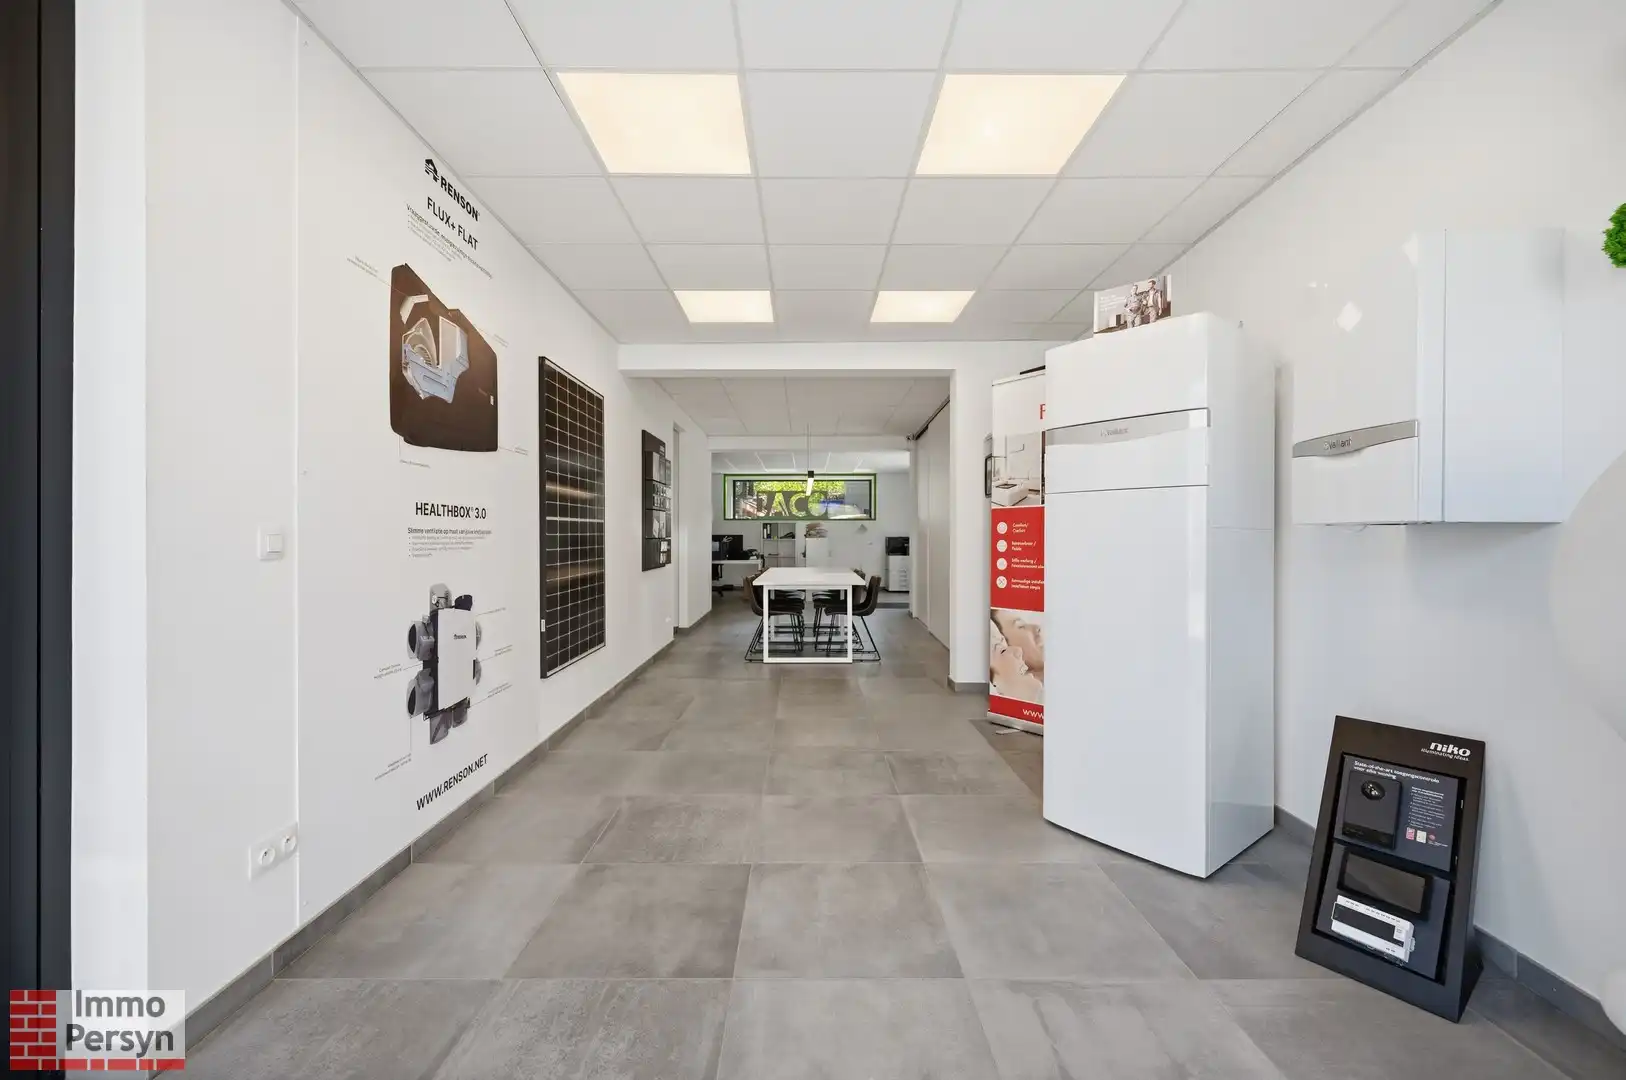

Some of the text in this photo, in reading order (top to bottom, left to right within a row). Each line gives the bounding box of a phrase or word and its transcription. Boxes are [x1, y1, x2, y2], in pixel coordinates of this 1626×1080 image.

[427, 196, 456, 230] FLUX+
[458, 224, 479, 251] FLAT
[474, 507, 487, 519] 3.0
[1429, 742, 1471, 757] niko
[416, 753, 488, 811] WWW.RENSON.NET
